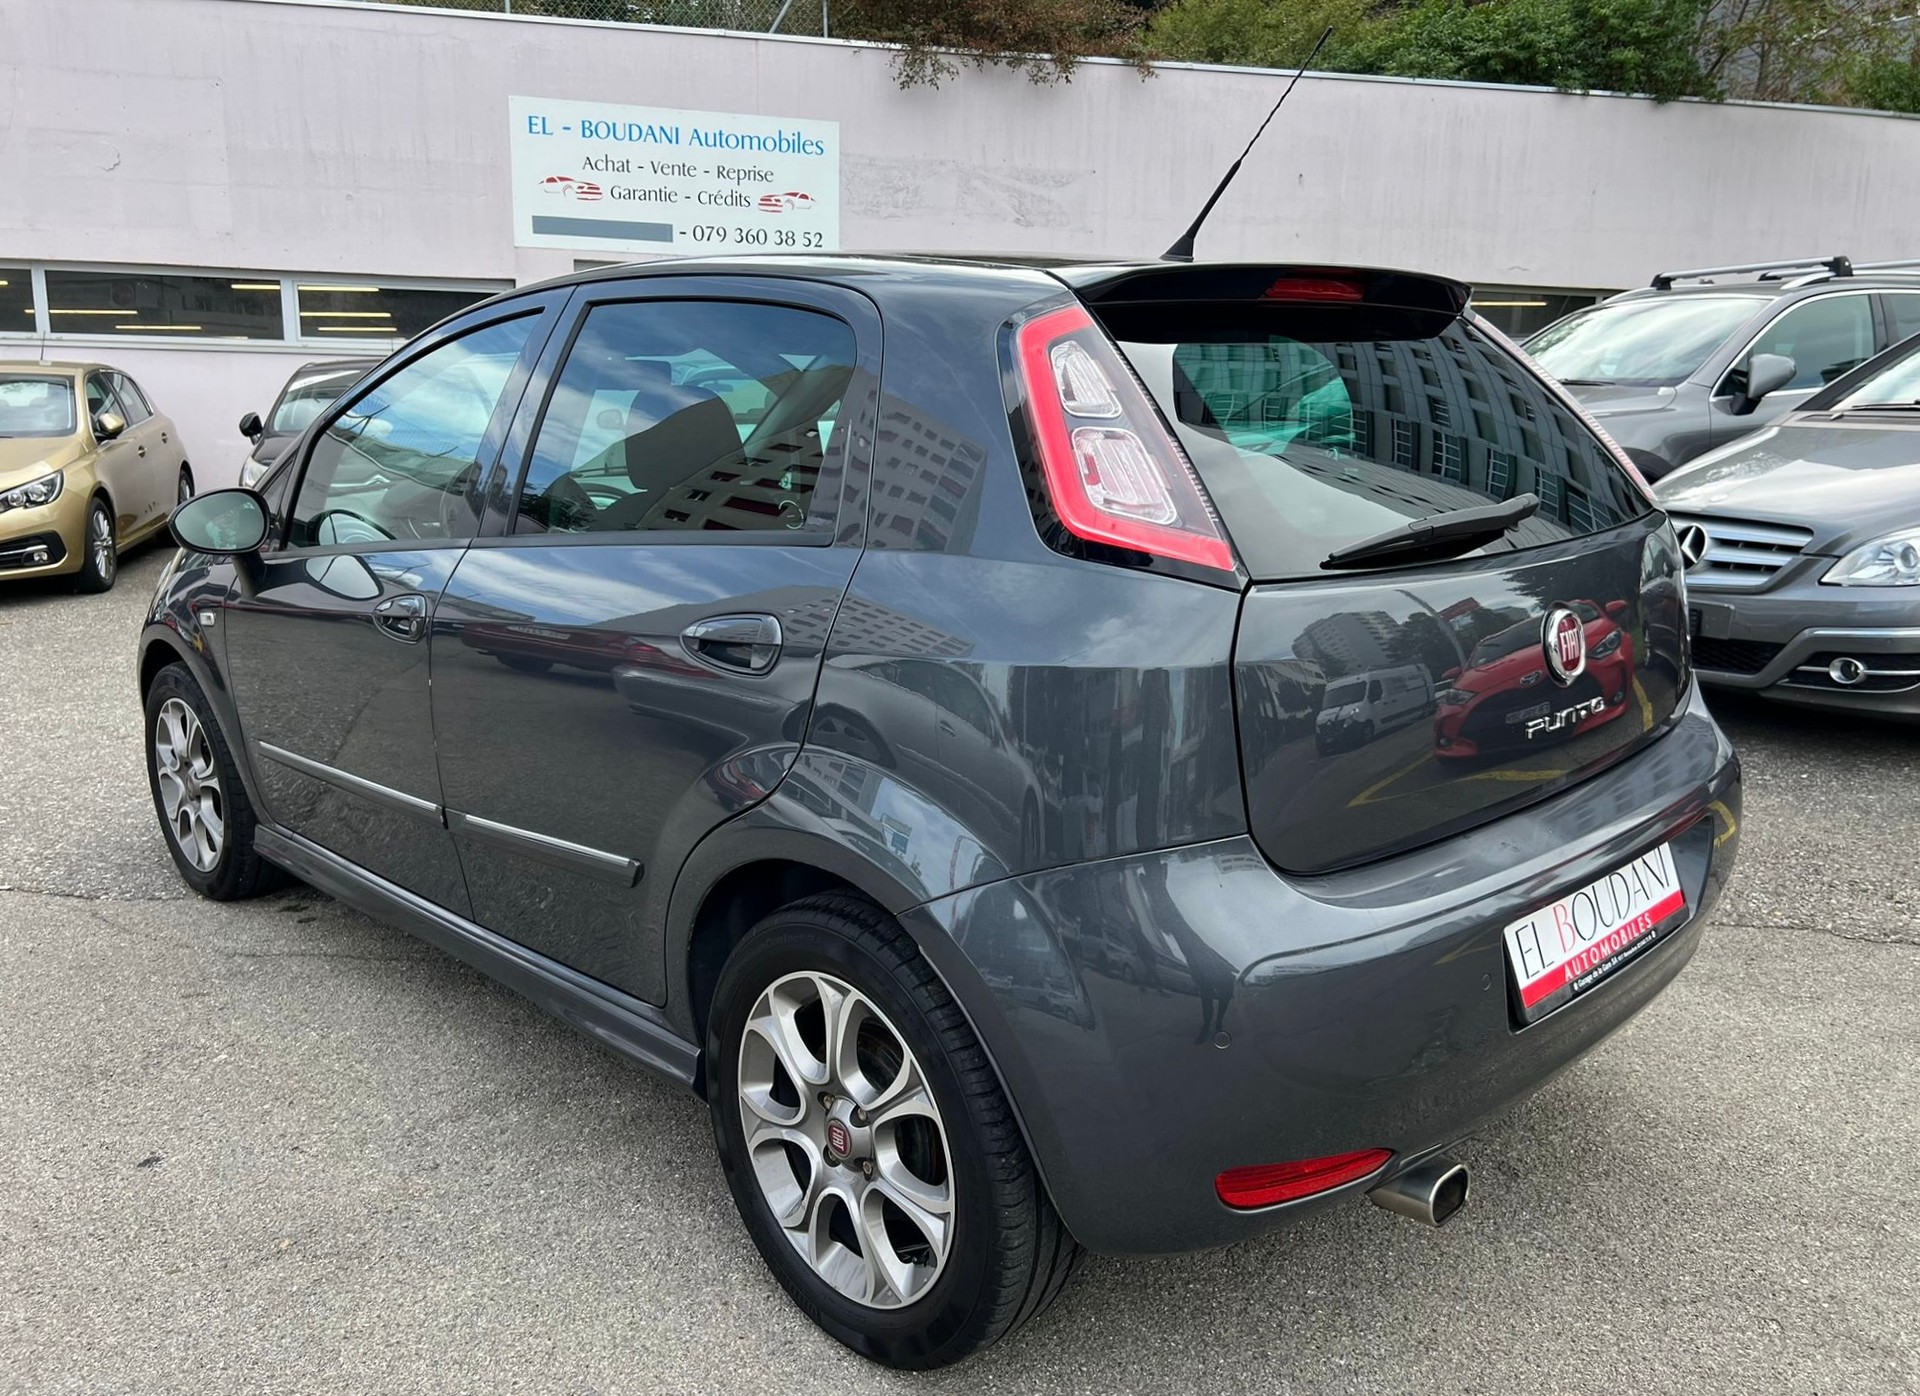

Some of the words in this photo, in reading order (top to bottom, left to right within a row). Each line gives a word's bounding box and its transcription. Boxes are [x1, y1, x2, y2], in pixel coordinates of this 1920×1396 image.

[527, 115, 554, 136] EL
[580, 119, 680, 145] BOUDANI
[688, 127, 825, 156] Automobiles
[582, 154, 632, 174] Achat
[650, 160, 697, 178] Vente
[716, 165, 774, 186] Reprise
[610, 184, 679, 204] Garantie
[697, 189, 751, 208] Crédits
[692, 225, 727, 244] 079
[734, 227, 768, 246] 360
[774, 230, 796, 247] 38
[802, 231, 823, 249] 52
[1559, 628, 1580, 662] FIAT
[1515, 921, 1555, 980] EL
[1553, 846, 1670, 954] BOUDANI
[1564, 913, 1652, 983] AUTOMOBILES
[832, 1127, 845, 1151] FIAT
